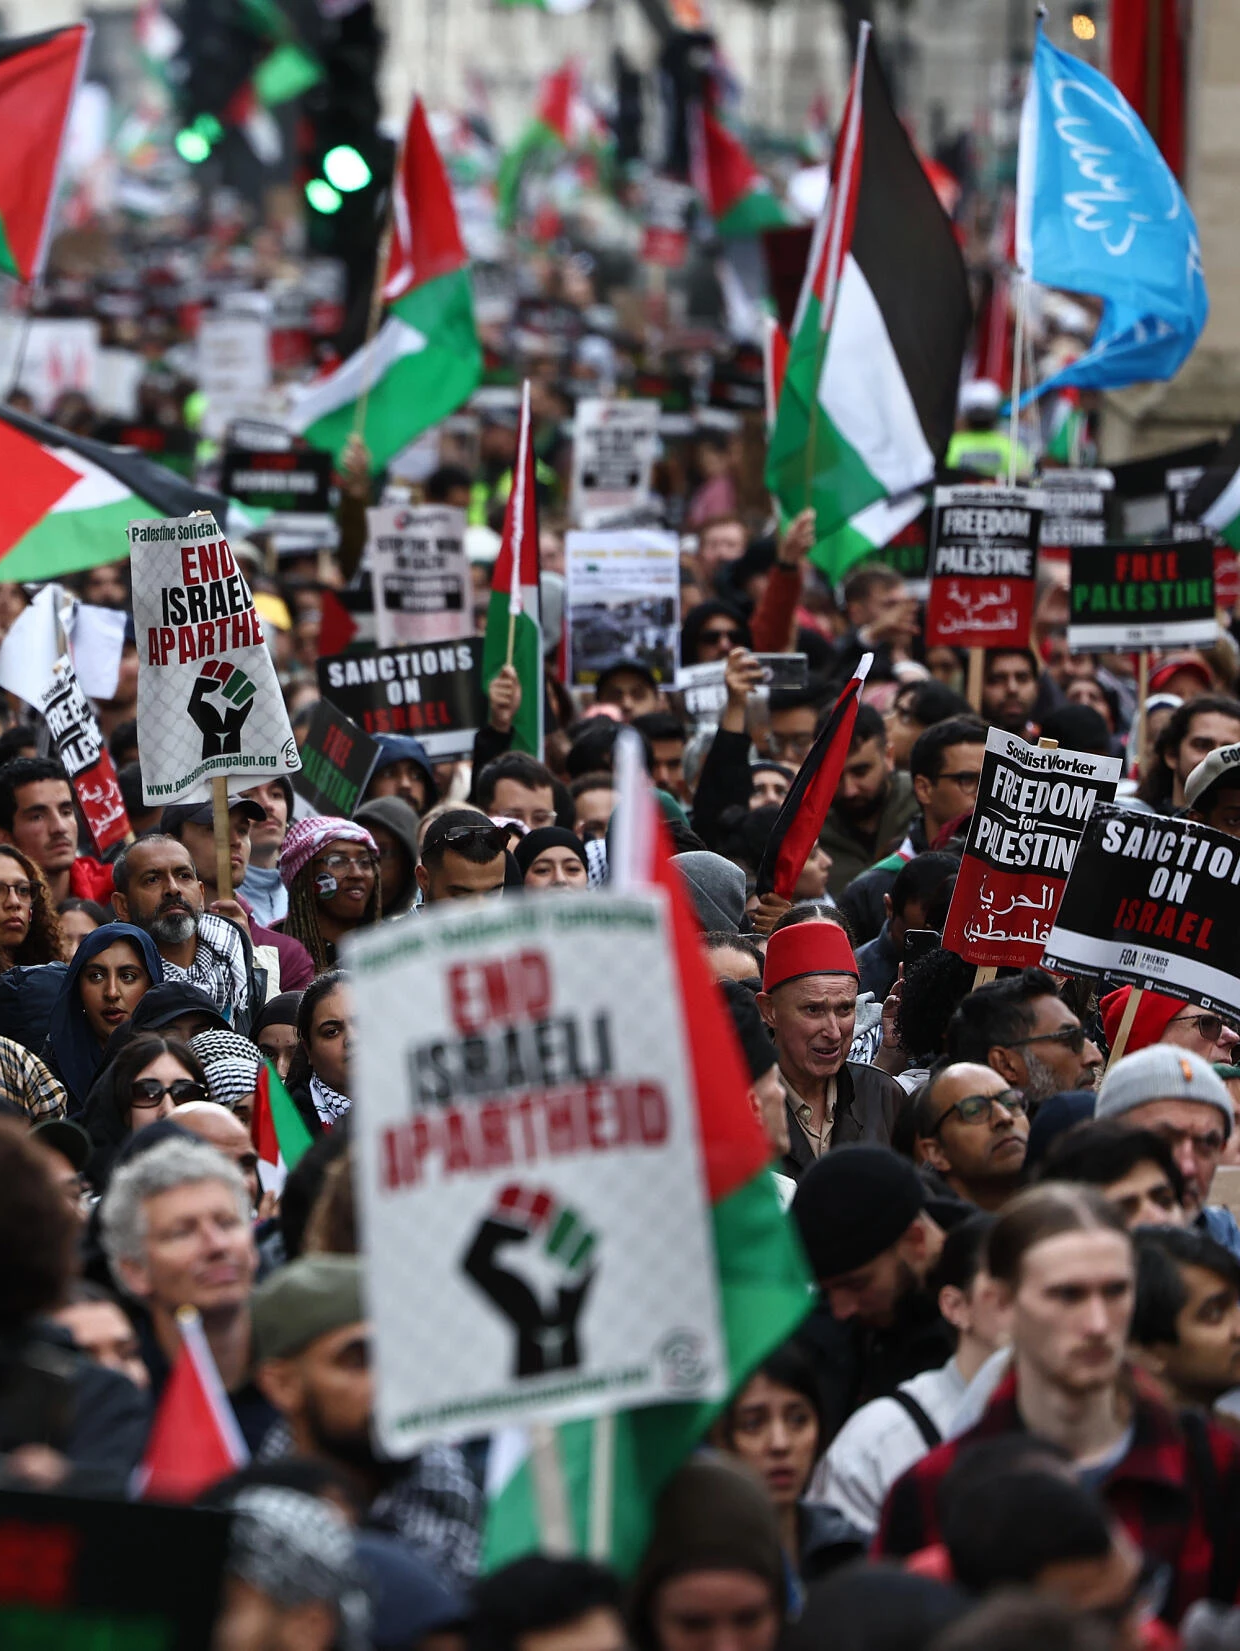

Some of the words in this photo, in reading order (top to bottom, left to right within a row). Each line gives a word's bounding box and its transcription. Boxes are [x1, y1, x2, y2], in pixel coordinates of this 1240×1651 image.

[131, 525, 176, 543] Palestine
[942, 508, 1032, 538] FREEDOM
[180, 540, 235, 586] END
[934, 545, 1032, 577] PALESTINE
[1115, 550, 1179, 583] FREE
[1073, 577, 1213, 613] PALESTINE
[327, 644, 474, 689] SANCTIONS
[385, 678, 422, 706] ON
[364, 700, 453, 734] ISRAEL
[1220, 747, 1240, 765] GO
[991, 763, 1098, 822] FREEDOM
[1018, 814, 1039, 832] for
[974, 815, 1082, 873] PALESTIN
[1148, 866, 1193, 906] ON
[1113, 897, 1215, 951] ISRAEL
[1119, 948, 1139, 967] FOA
[1141, 952, 1170, 968] FRIENDS
[445, 945, 553, 1033] END
[407, 1008, 615, 1110] ISRAELI
[376, 1077, 670, 1194] APARTHEID
